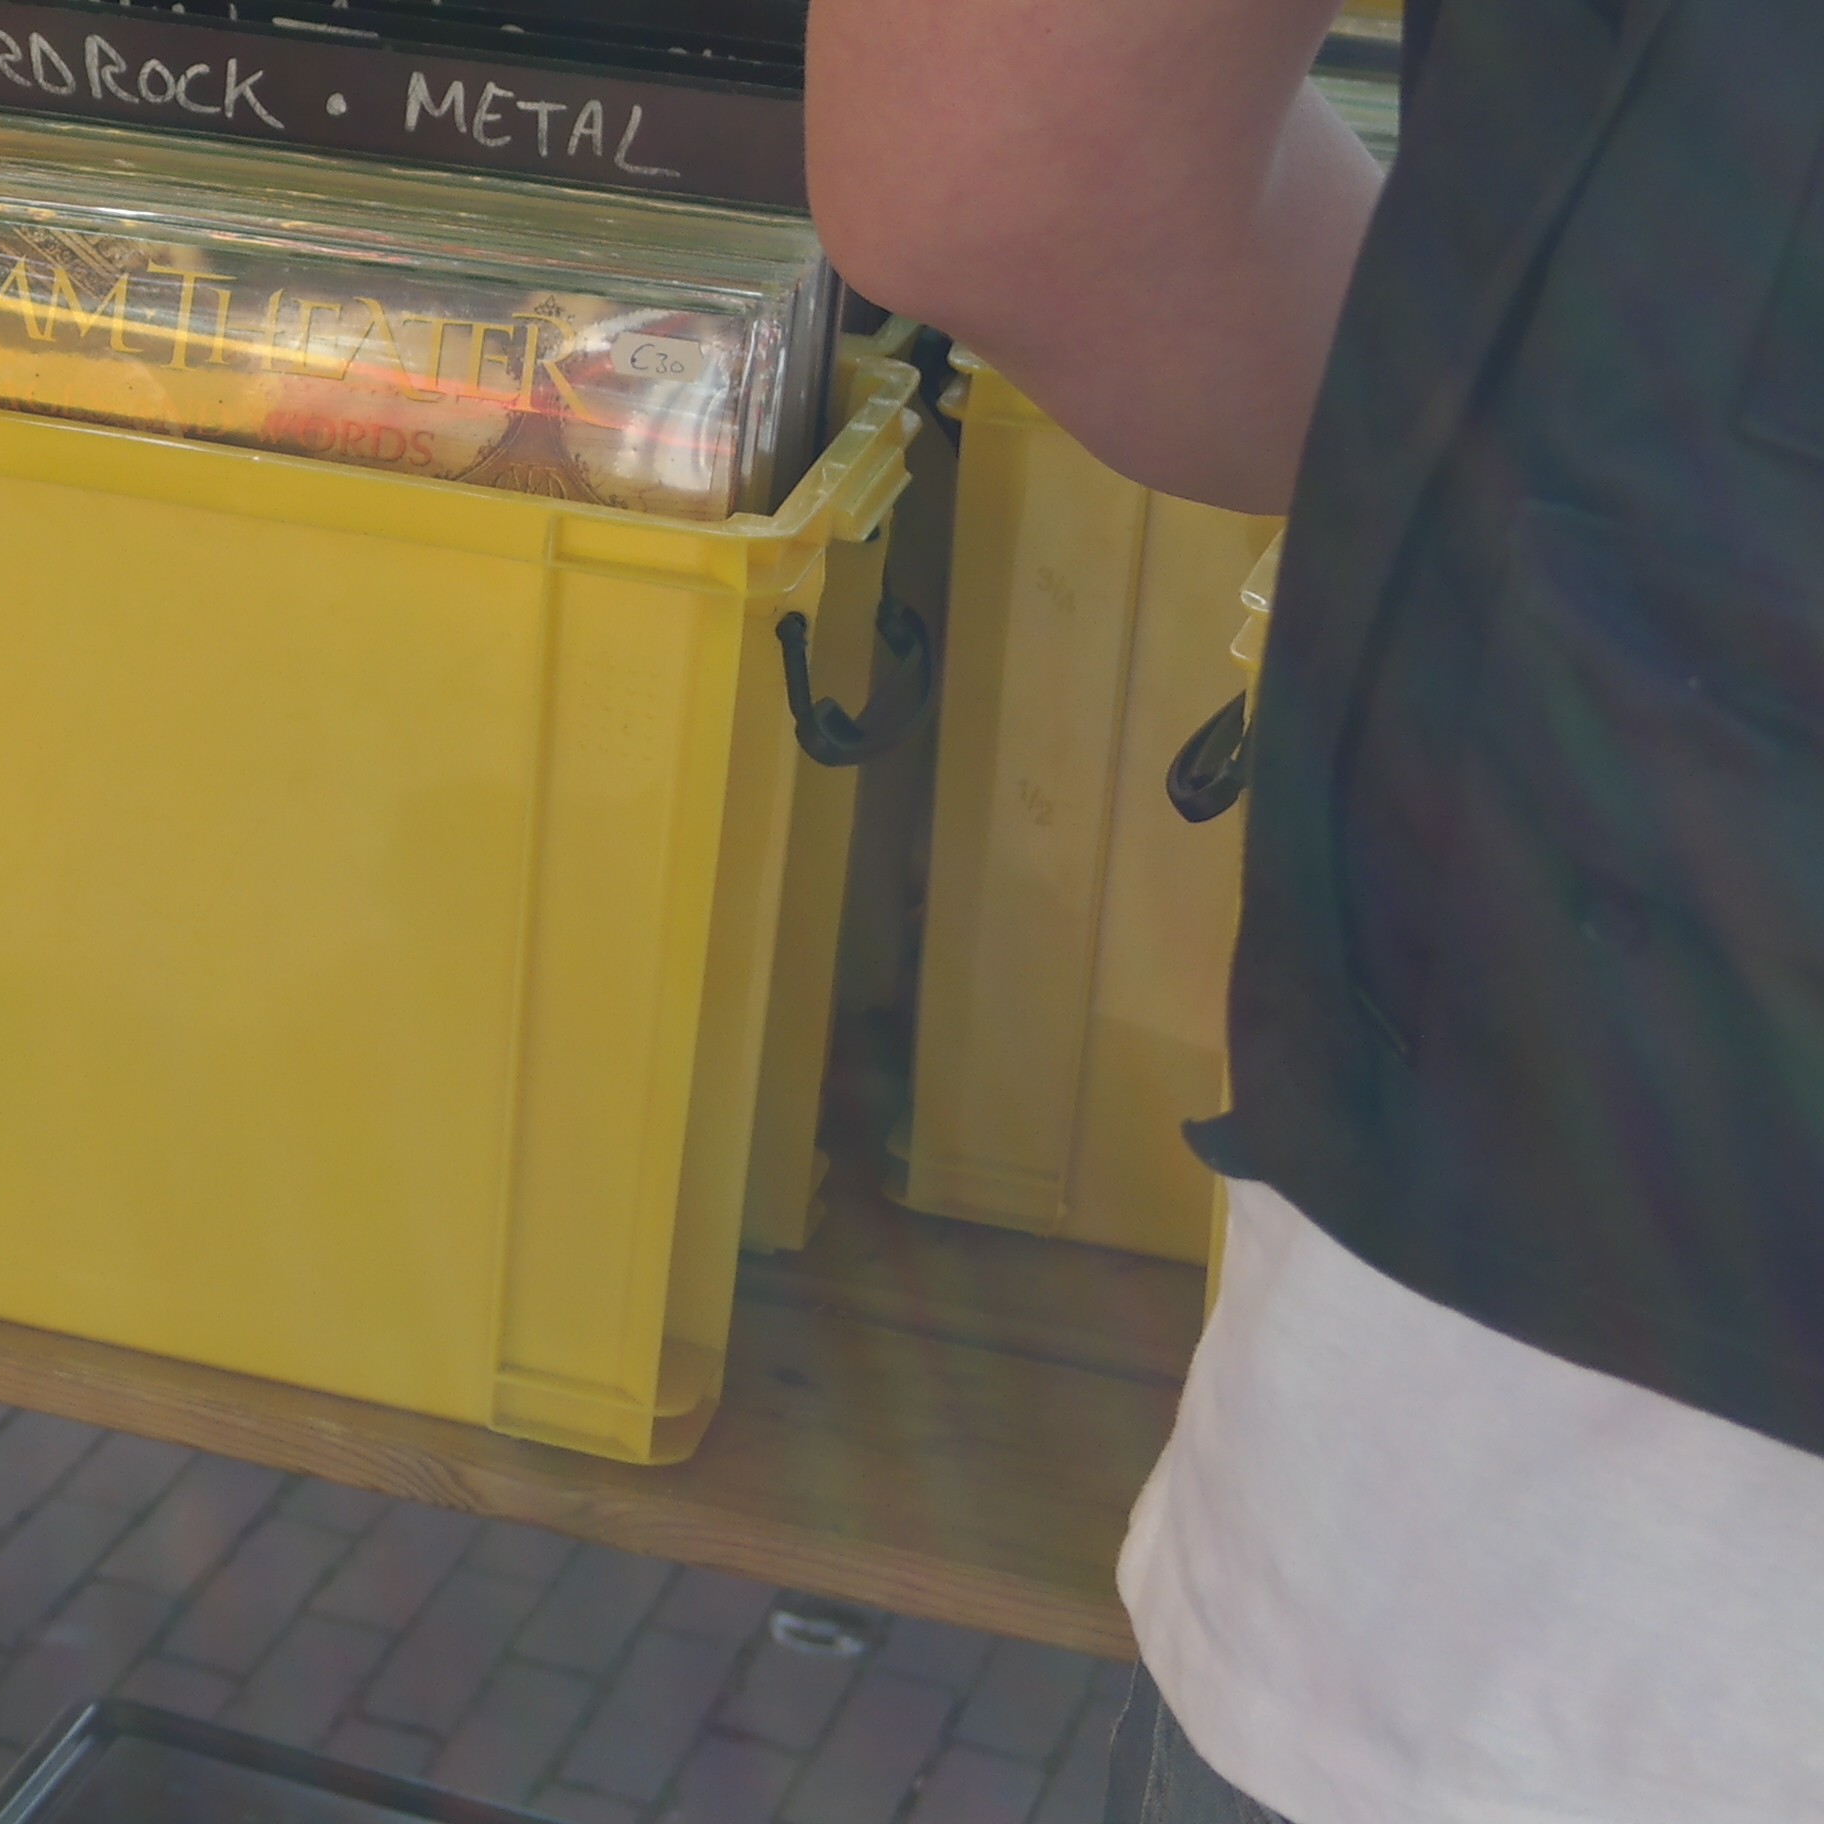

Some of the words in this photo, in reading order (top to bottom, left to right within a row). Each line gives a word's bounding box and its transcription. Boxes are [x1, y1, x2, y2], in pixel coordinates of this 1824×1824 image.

[404, 70, 682, 179] METAL
[145, 260, 629, 431] THEATER
[628, 342, 687, 375] €30
[260, 410, 437, 468] WORDS
